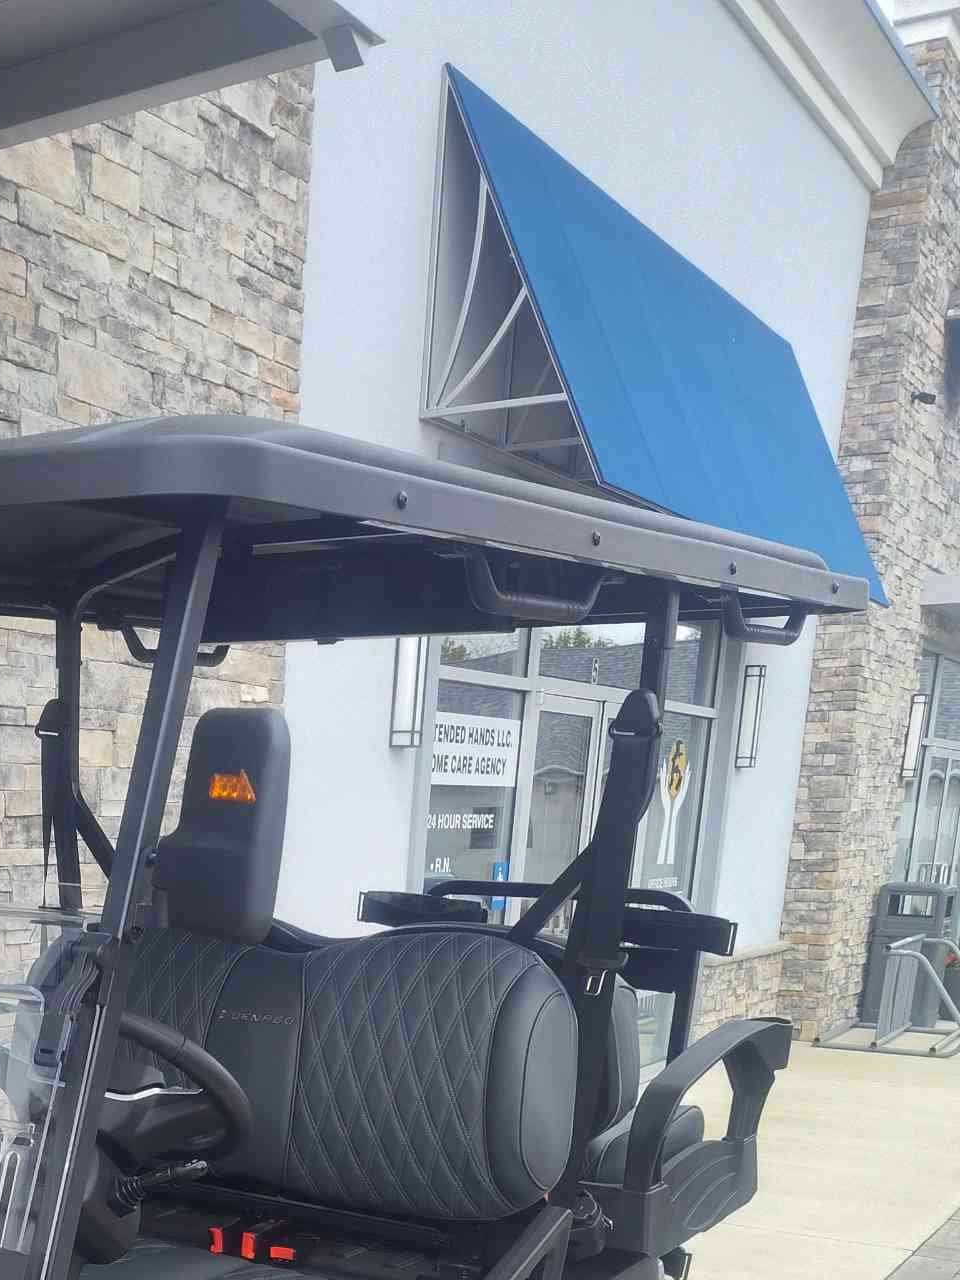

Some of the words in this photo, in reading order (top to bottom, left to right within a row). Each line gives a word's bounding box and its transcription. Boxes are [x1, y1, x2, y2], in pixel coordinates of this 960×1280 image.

[592, 658, 599, 684] 5
[433, 723, 466, 744] TENDED
[468, 727, 495, 747] HANDS
[496, 729, 513, 748] LLC.
[450, 755, 473, 774] CARE
[474, 756, 507, 776] AGENCY
[437, 813, 461, 829] HOUR
[462, 813, 495, 829] SERVICE
